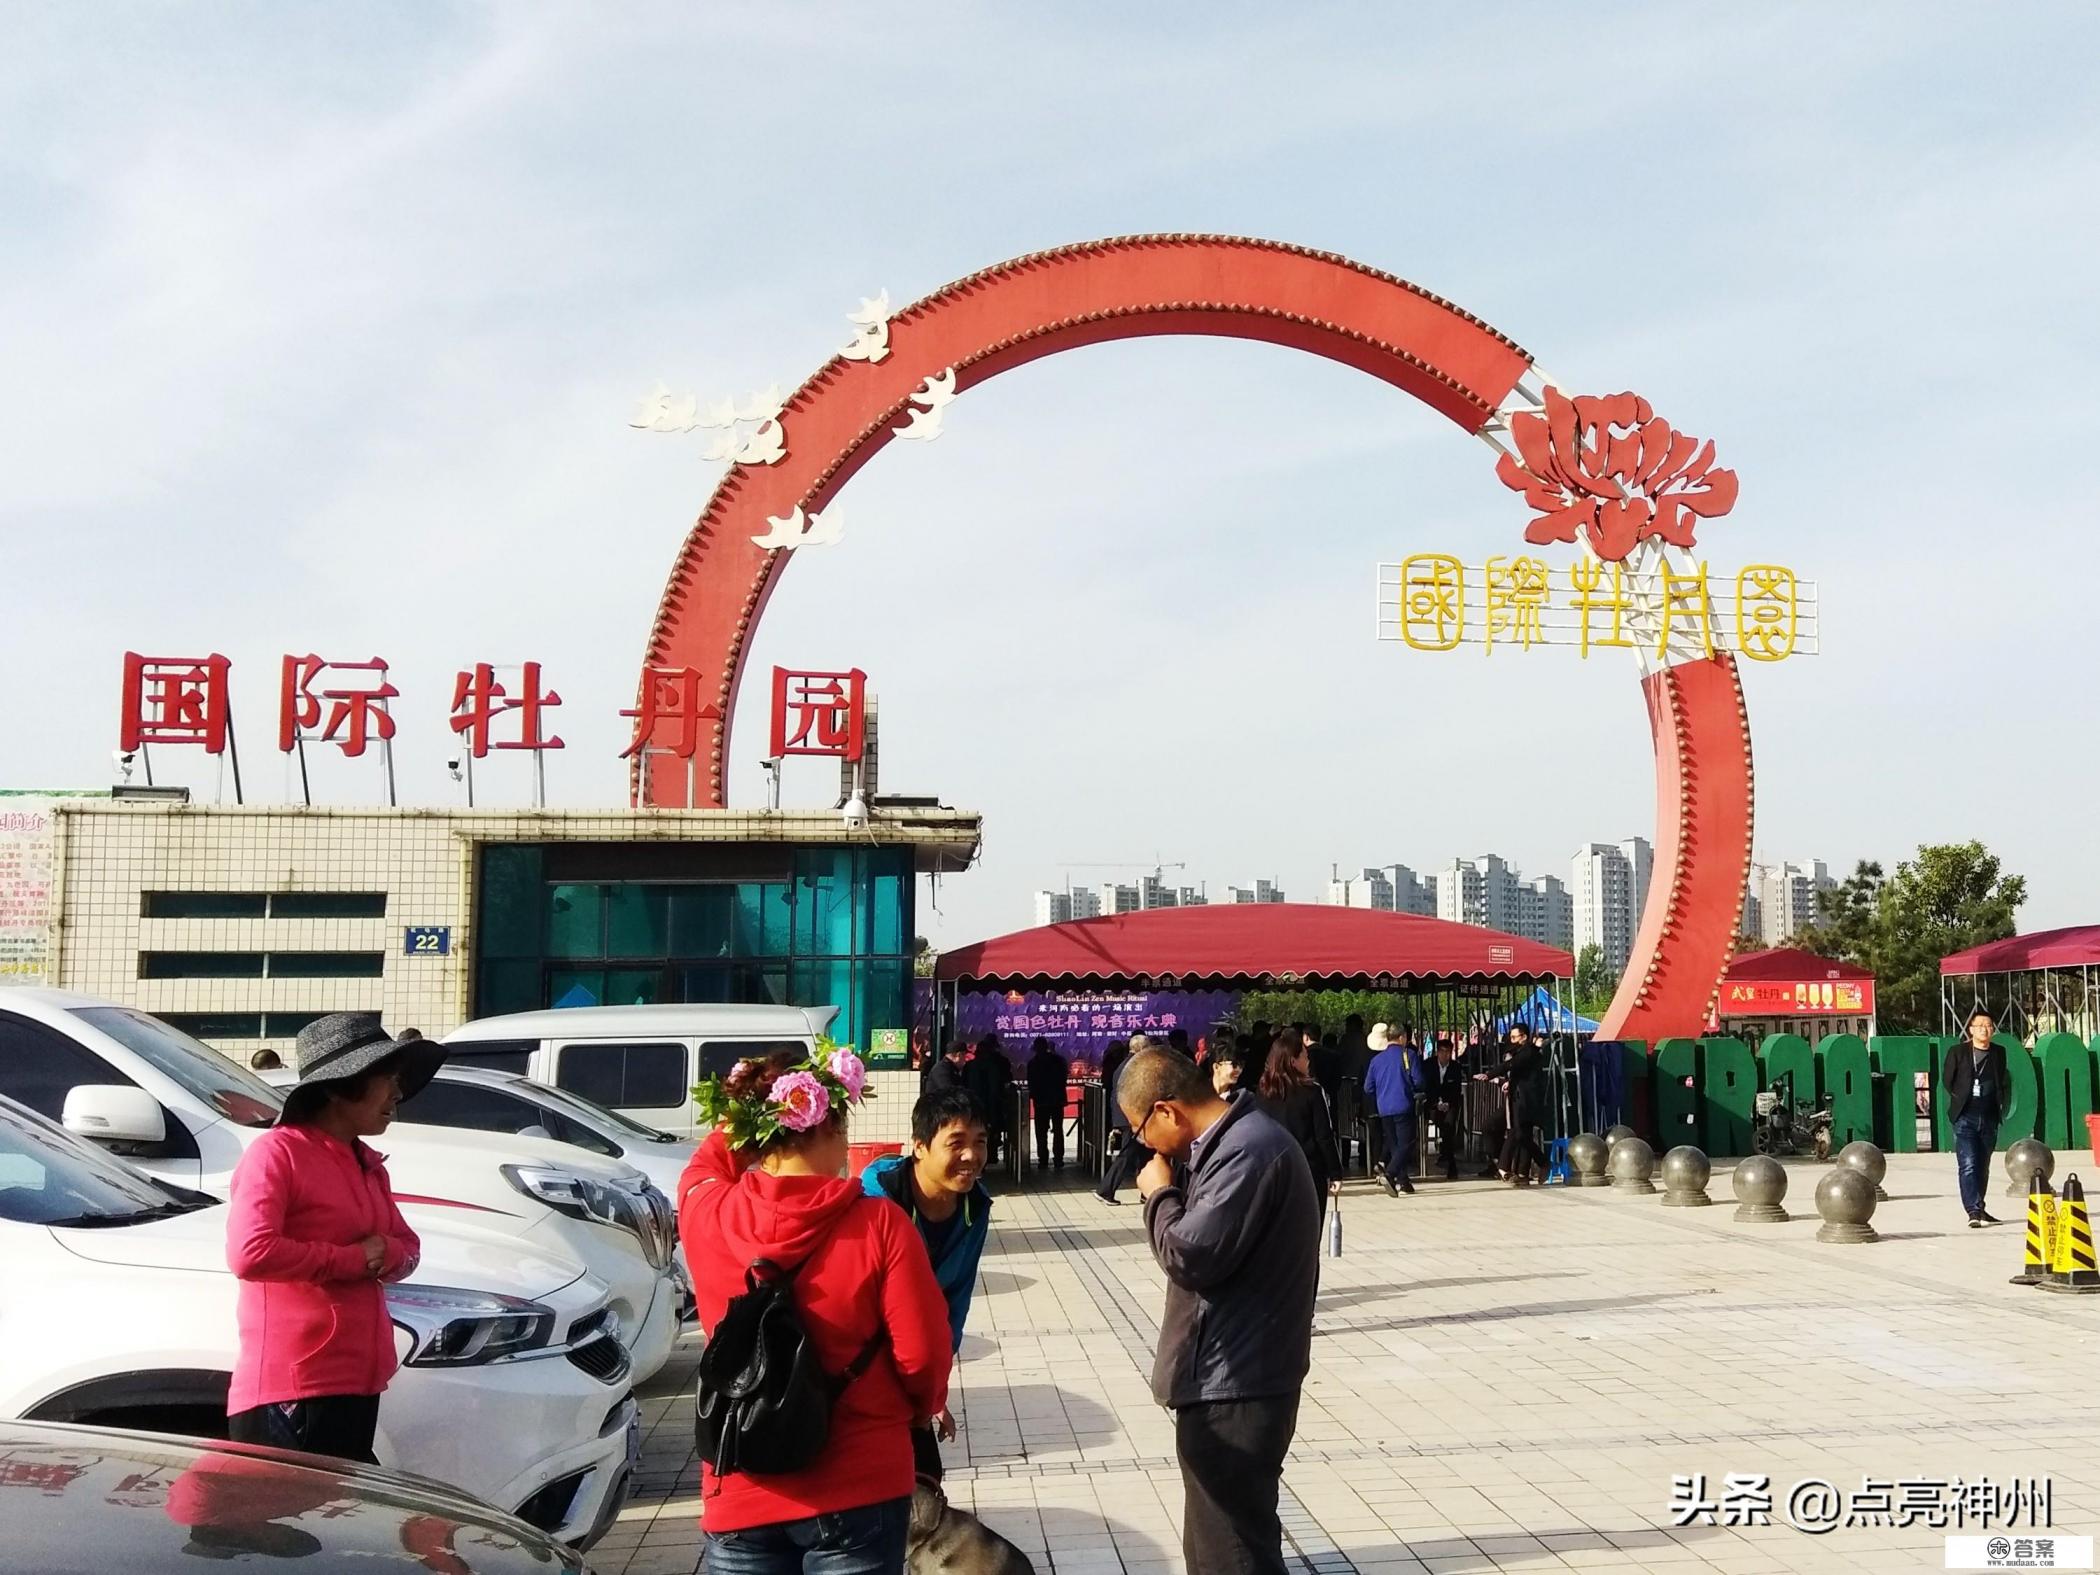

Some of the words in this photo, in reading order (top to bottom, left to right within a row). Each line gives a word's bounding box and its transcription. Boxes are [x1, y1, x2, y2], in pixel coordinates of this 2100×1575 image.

[120, 651, 867, 762] 国际牡丹园
[415, 934, 439, 950] 22
[1460, 984, 1499, 994] 证件通道
[1039, 1004, 1143, 1012] 来河南必看的一场演出
[995, 1015, 1082, 1030] 赏国色牡丹
[1091, 1013, 1177, 1028] 观音乐大典
